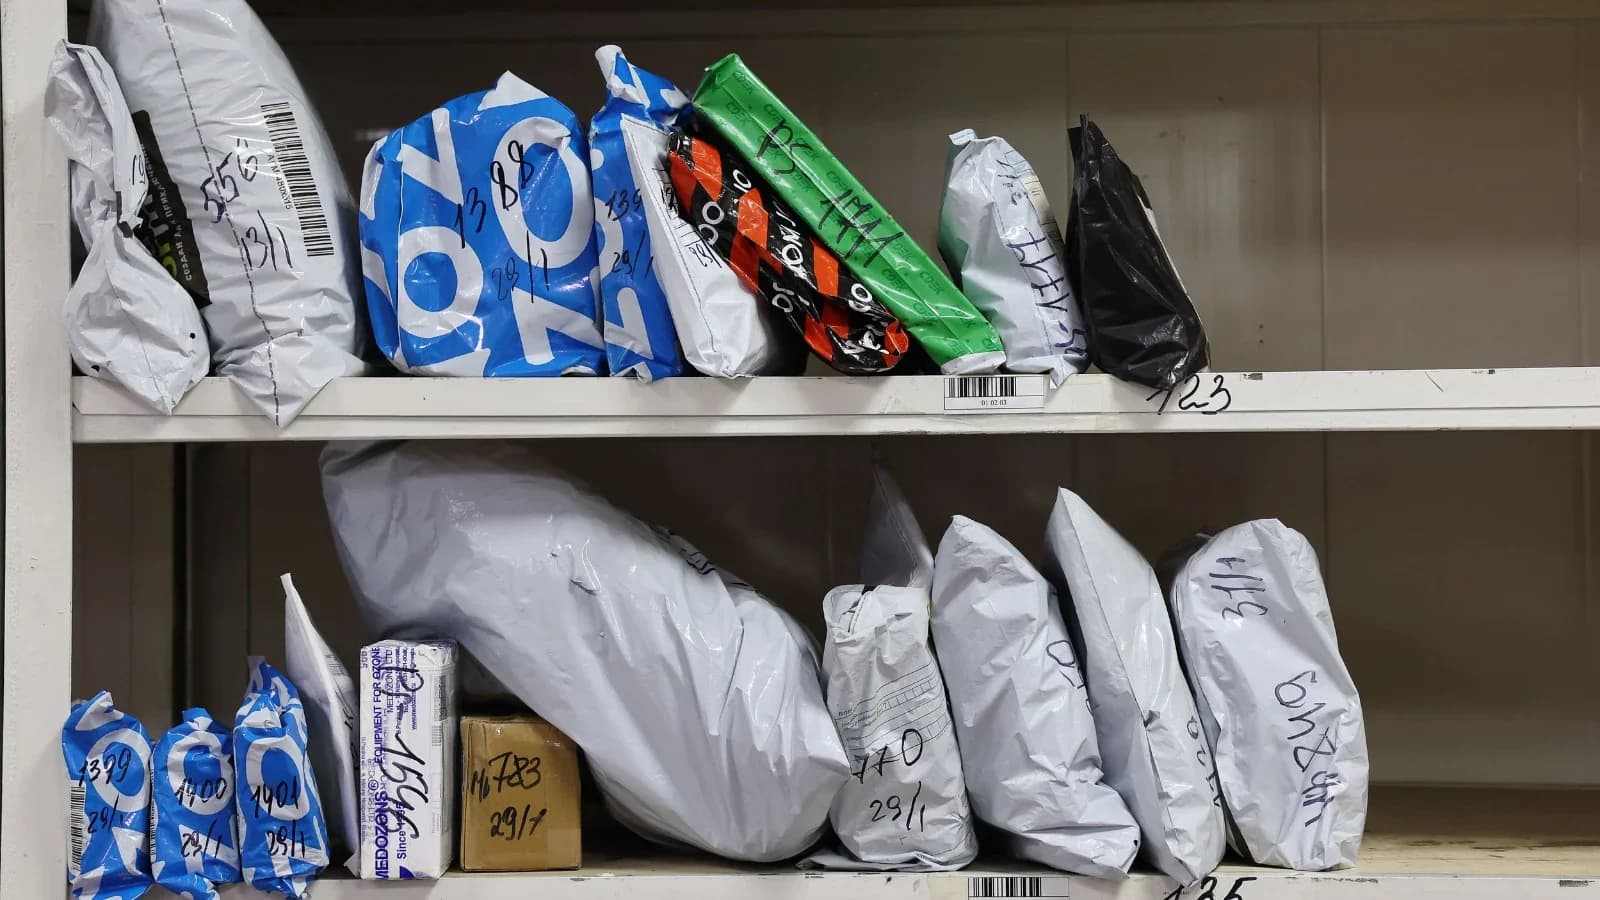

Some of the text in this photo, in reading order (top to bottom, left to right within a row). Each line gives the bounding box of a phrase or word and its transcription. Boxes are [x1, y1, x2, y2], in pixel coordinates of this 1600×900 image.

[1146, 374, 1232, 415] 123
[373, 680, 381, 703] FOR
[174, 776, 227, 810] 1400
[250, 775, 300, 817] 1401
[869, 781, 925, 832] 29/1
[182, 818, 223, 858] 29/1
[266, 819, 306, 859] 29/1
[490, 804, 547, 841] 29/1
[397, 830, 406, 860] Since
